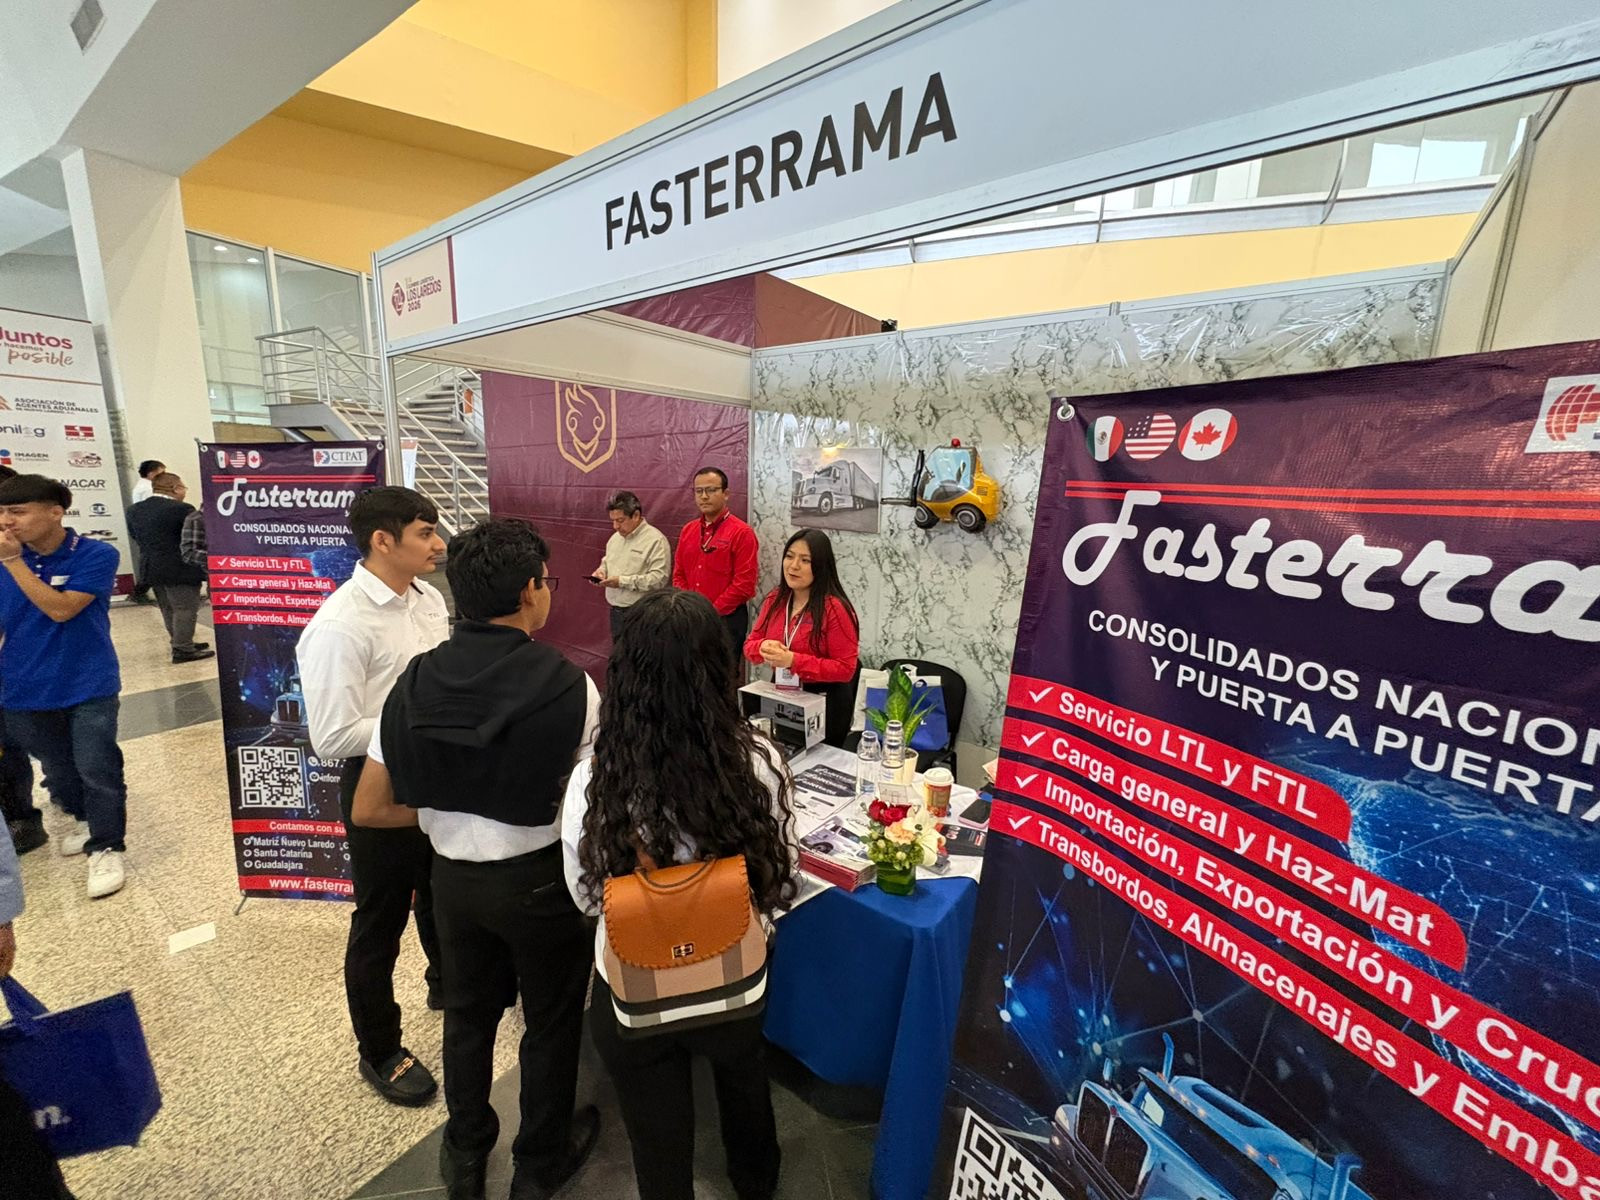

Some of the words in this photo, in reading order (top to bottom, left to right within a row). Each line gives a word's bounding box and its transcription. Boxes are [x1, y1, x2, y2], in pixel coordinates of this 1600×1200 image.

[604, 71, 958, 251] FASTERRAMA
[406, 287, 417, 301] LOS
[417, 280, 442, 298] LAREDOS
[8, 349, 73, 367] posible
[53, 405, 99, 413] ADUANALES
[331, 451, 363, 462] CTPAT
[233, 523, 306, 534] CONSOLIDADOS
[307, 525, 353, 535] NACIONA
[256, 535, 263, 545] Y
[264, 536, 301, 546] PUERTA
[301, 536, 310, 546] A
[310, 537, 348, 547] PUERTA
[230, 557, 264, 569] Servicio
[266, 559, 281, 569] LTL
[283, 561, 288, 571] y
[290, 560, 306, 570] FTL
[231, 577, 257, 588] Carga
[259, 579, 289, 589] general
[292, 580, 297, 590] y
[298, 579, 332, 590] Haz-Mat
[233, 594, 285, 606] Importación,
[235, 612, 287, 624] Transbordos,
[1088, 609, 1360, 700] CONSOLIDADOS
[1151, 655, 1171, 681] Y
[1176, 664, 1316, 734] PUERTA
[1324, 713, 1360, 748] A
[1058, 691, 1152, 747] Servicio
[1159, 729, 1214, 774] LTL
[1220, 758, 1243, 788] y
[1251, 764, 1318, 819] FTL
[269, 821, 315, 832] Contamos
[316, 824, 333, 833] con
[253, 837, 280, 847] Matriz
[281, 837, 306, 848] Nuevo
[308, 839, 335, 849] Laredo
[1051, 737, 1115, 785] Carga
[1120, 774, 1229, 838] general
[1234, 826, 1257, 855] y
[1265, 834, 1436, 947] Haz-Mat
[253, 849, 278, 857] Santa
[280, 849, 313, 858] Catarina
[254, 859, 304, 871] Guadalajara
[269, 877, 354, 893] www.fasterra
[1044, 776, 1185, 877] Importación,
[1194, 856, 1414, 1005] Exportación
[1425, 993, 1460, 1031] y
[1037, 820, 1175, 929] Transbordos,
[1180, 911, 1398, 1069] Almacenajes
[1408, 1061, 1440, 1097] y
